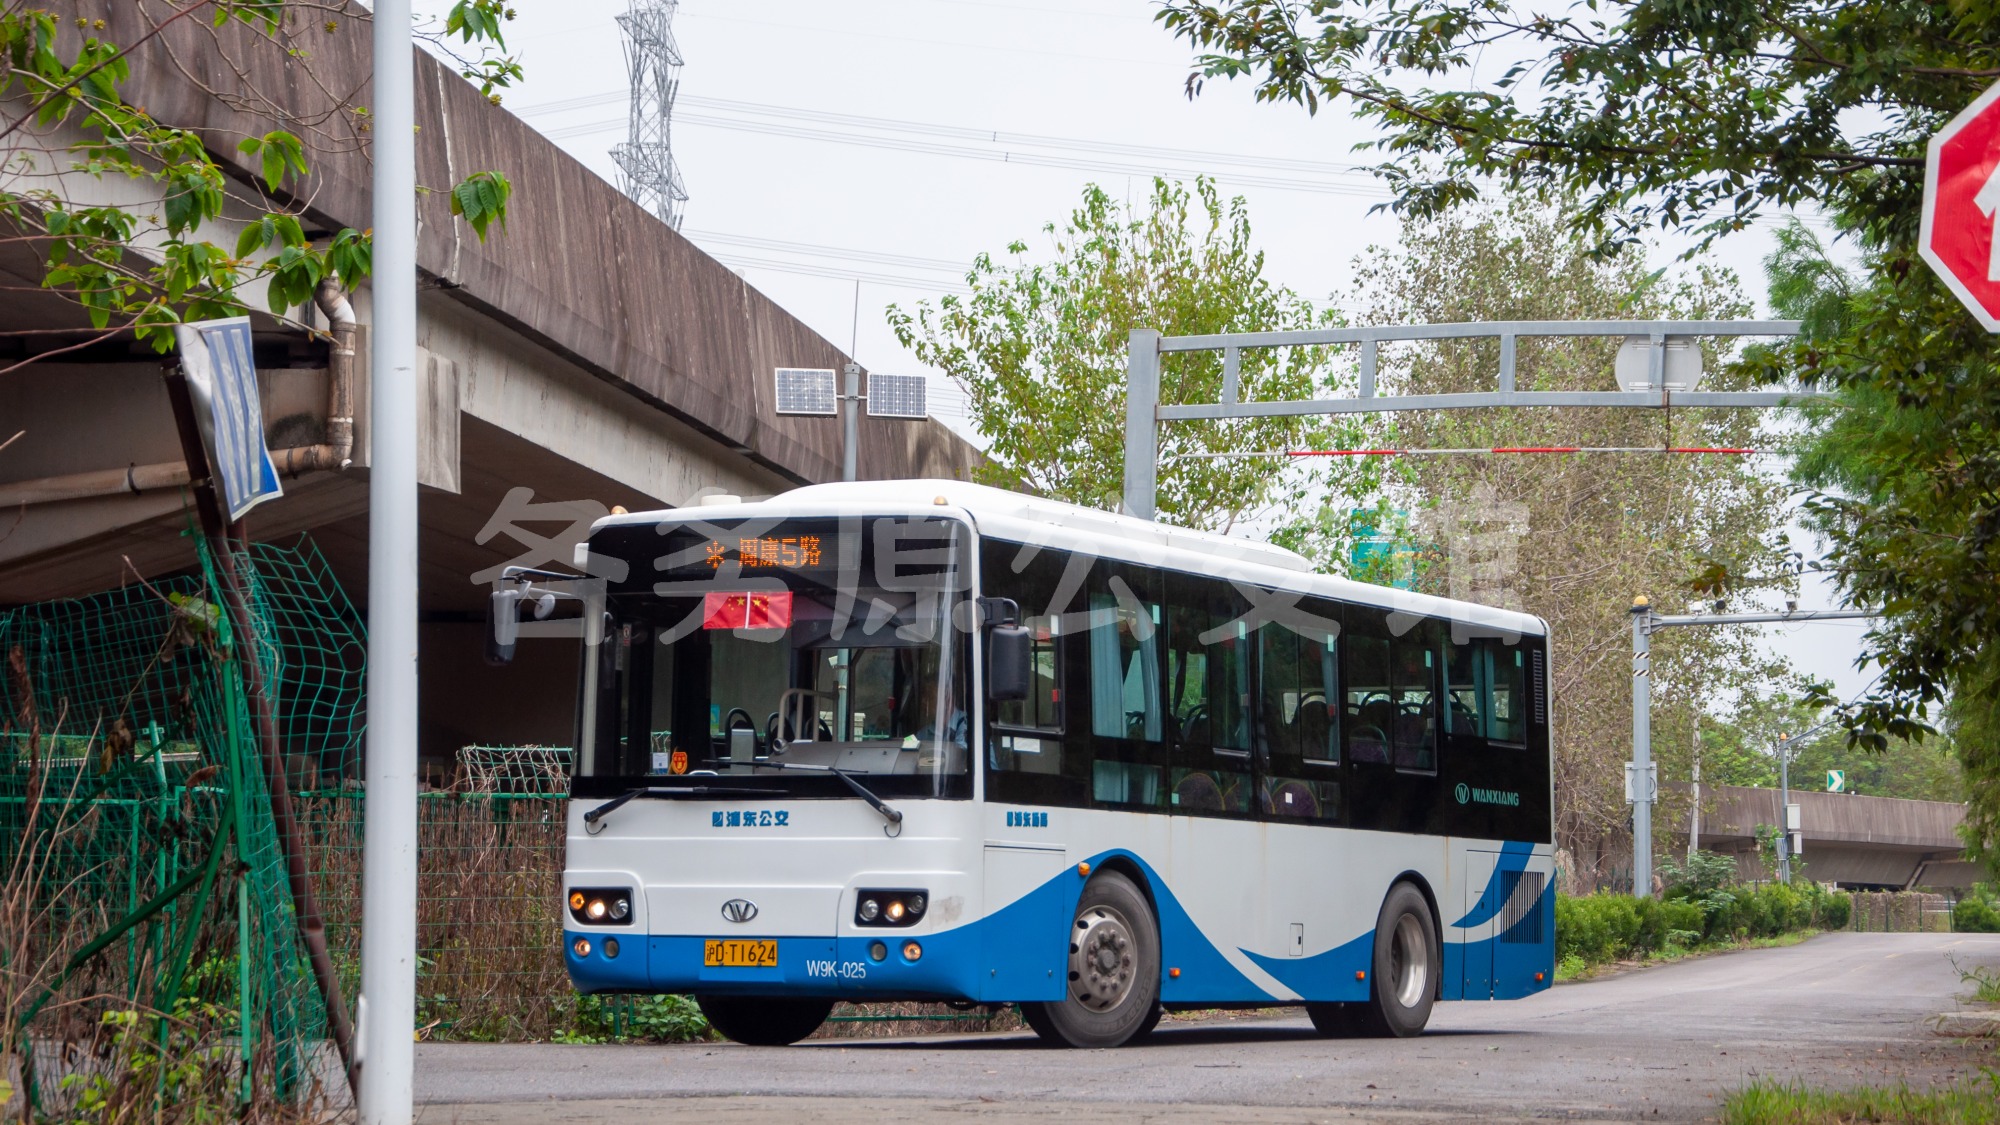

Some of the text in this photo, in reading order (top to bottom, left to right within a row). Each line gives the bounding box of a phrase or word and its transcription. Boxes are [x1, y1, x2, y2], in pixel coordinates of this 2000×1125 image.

[738, 535, 822, 567] 周康5路
[1472, 788, 1519, 806] WANXIANG
[726, 810, 789, 827] 浦东公交
[806, 960, 867, 979] W9K-025
